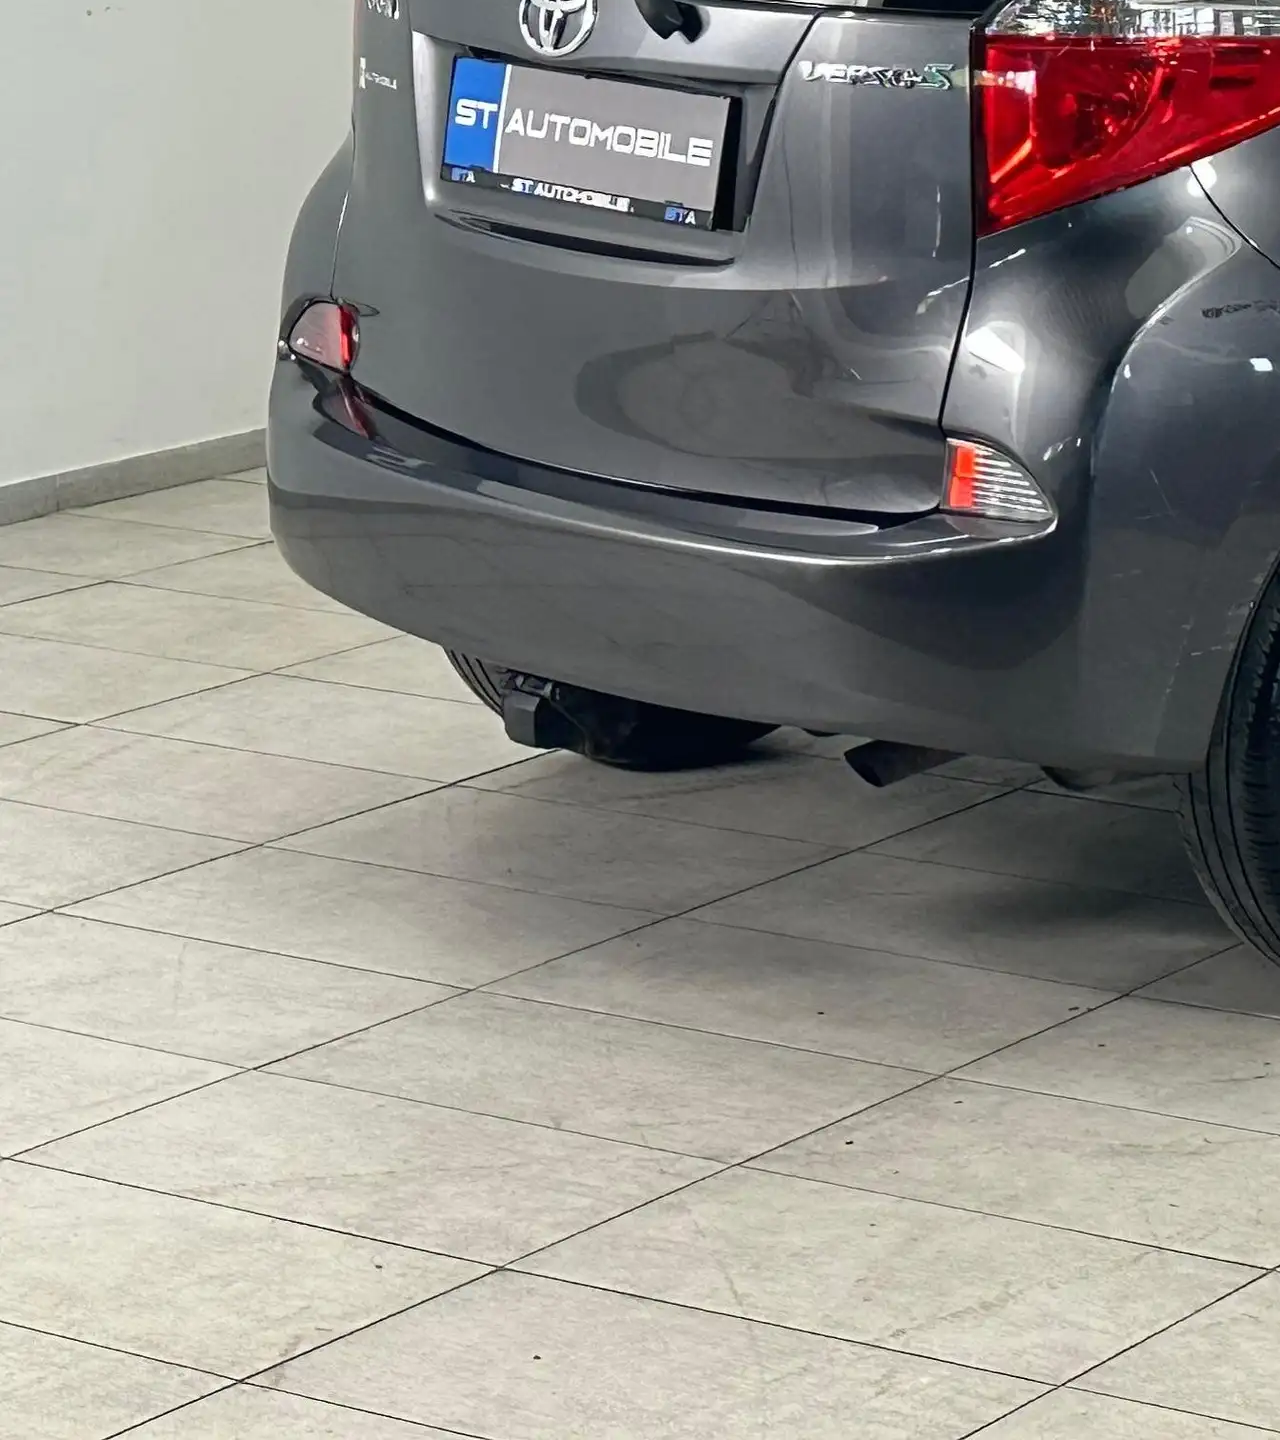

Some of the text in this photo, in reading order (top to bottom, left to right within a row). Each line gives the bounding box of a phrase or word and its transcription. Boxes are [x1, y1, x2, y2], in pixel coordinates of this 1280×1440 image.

[455, 98, 714, 167] ST AUTOMOBILE
[512, 178, 534, 194] ST
